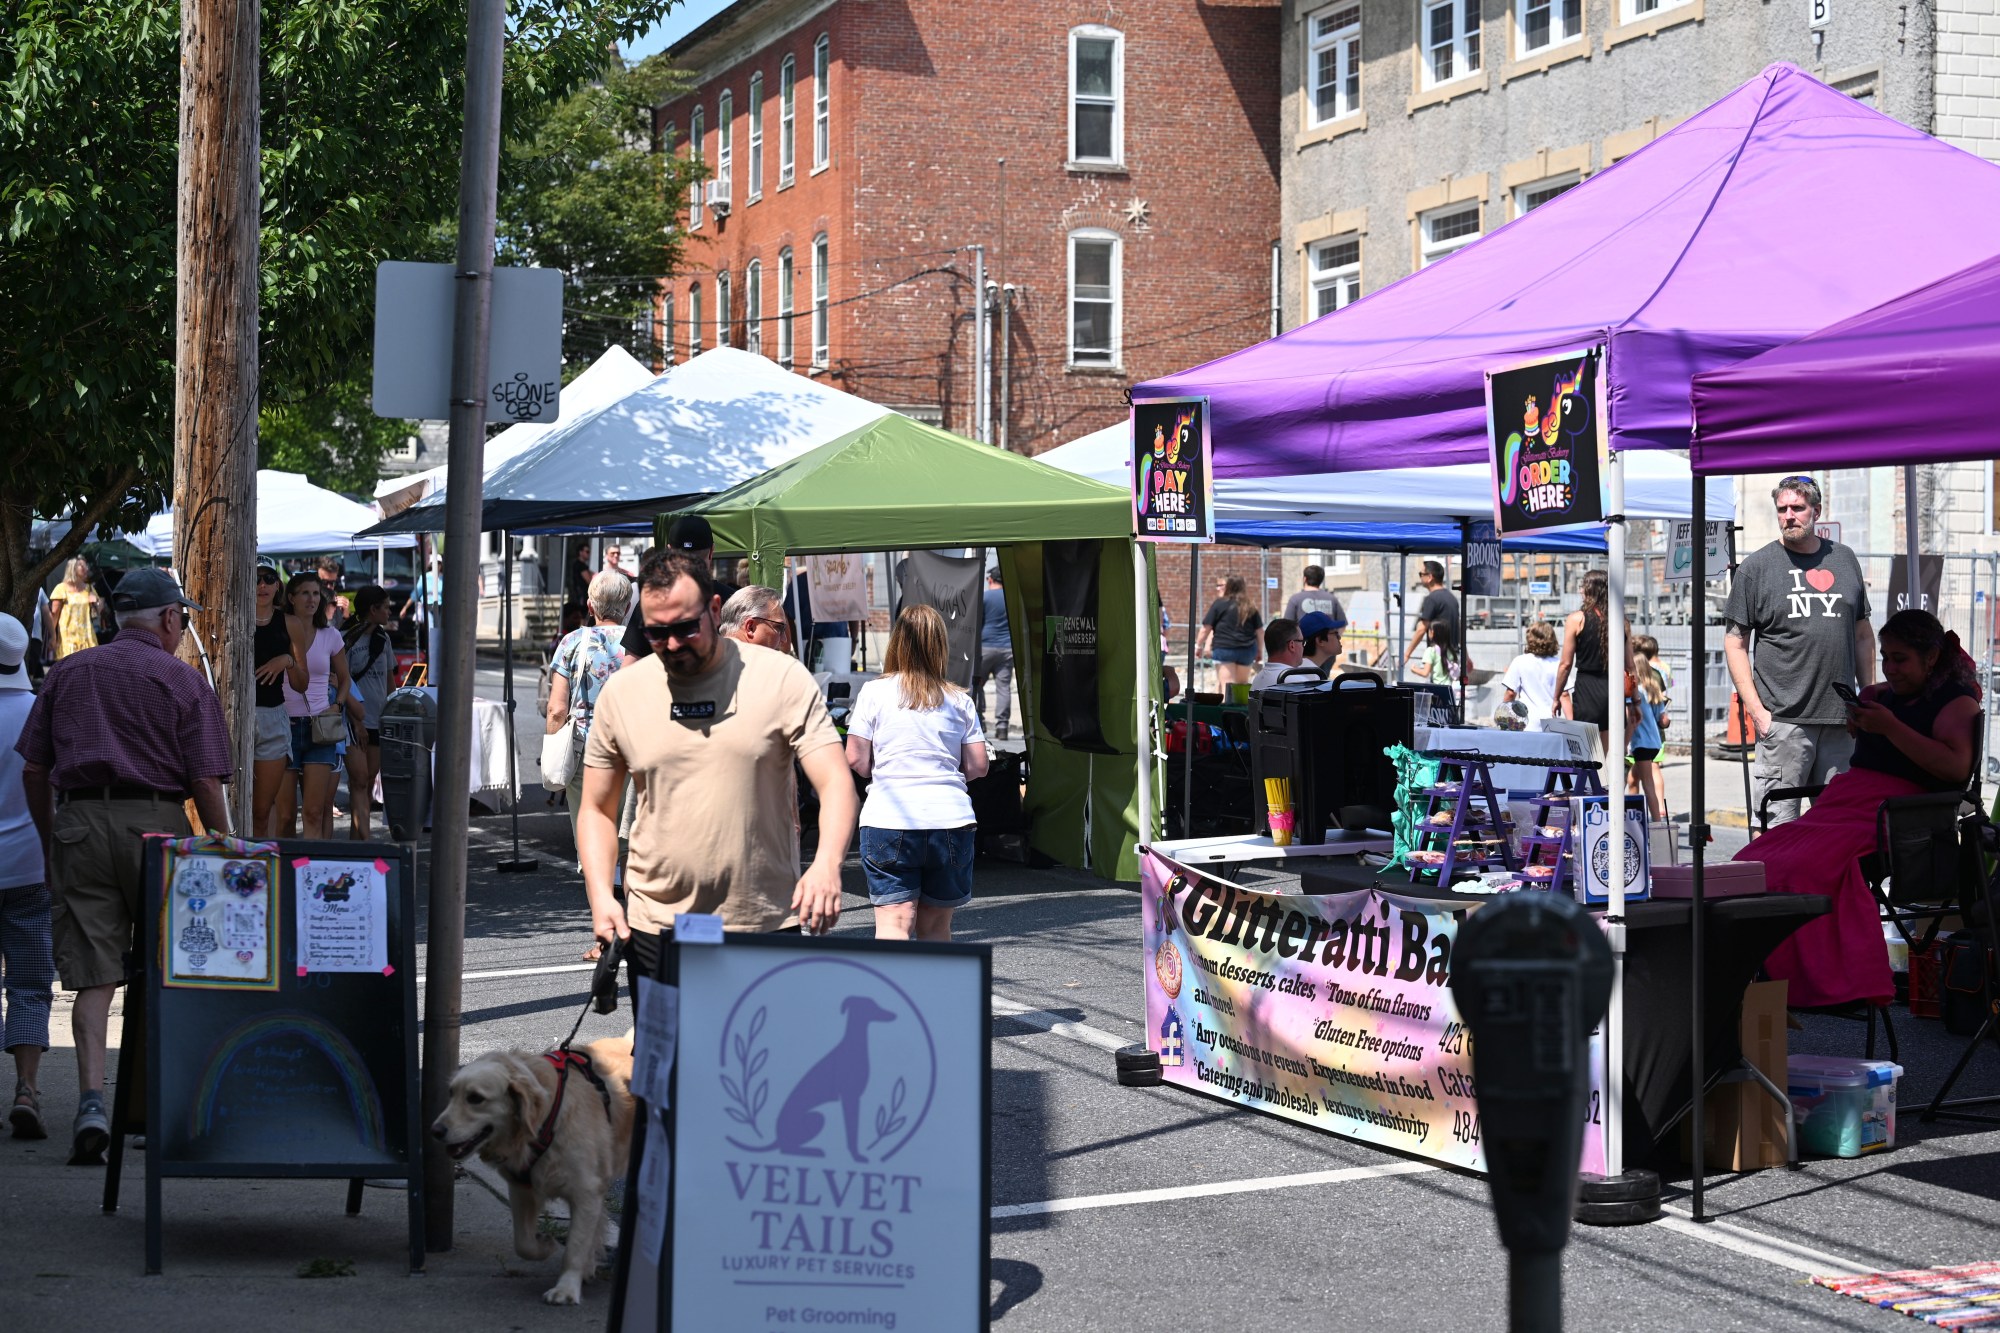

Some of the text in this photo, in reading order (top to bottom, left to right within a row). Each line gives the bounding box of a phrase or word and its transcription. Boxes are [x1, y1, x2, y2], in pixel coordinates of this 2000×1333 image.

[1154, 469, 1187, 493] PAY
[1520, 460, 1570, 490] ORDER
[1155, 493, 1185, 513] HERE
[1528, 484, 1565, 512] HERE
[1676, 523, 1690, 540] JEFF
[1817, 528, 1831, 538] NO
[1467, 543, 1500, 569] BROOKS
[1788, 569, 1806, 592] I
[1896, 592, 1928, 611] SAE
[1063, 617, 1096, 630] RENEWAL
[1069, 633, 1096, 644] ANDERSEN
[1182, 875, 1390, 978] Glitteratti
[1220, 957, 1276, 992] desserts,
[1278, 974, 1316, 1002] cakes,
[1194, 986, 1236, 1017] and more!
[1391, 993, 1432, 1021] flavors
[1355, 1029, 1382, 1052] Free
[1382, 1036, 1424, 1062] options
[1438, 1021, 1467, 1056] 425
[1219, 1035, 1262, 1062] occasions
[1261, 1049, 1274, 1067] or
[1274, 1054, 1308, 1078] events
[1243, 1077, 1263, 1100] and
[1264, 1083, 1318, 1116] wholesale
[1383, 1073, 1401, 1095] in
[1399, 1076, 1434, 1101] food
[1437, 1066, 1478, 1099] Cata
[1322, 1096, 1429, 1143] texture sensitivity
[725, 1161, 922, 1213] VELVET
[751, 1210, 894, 1259] TAILS
[722, 1255, 915, 1279] LUXURY PET SERVICES
[766, 1306, 896, 1330] Pet Grooming
